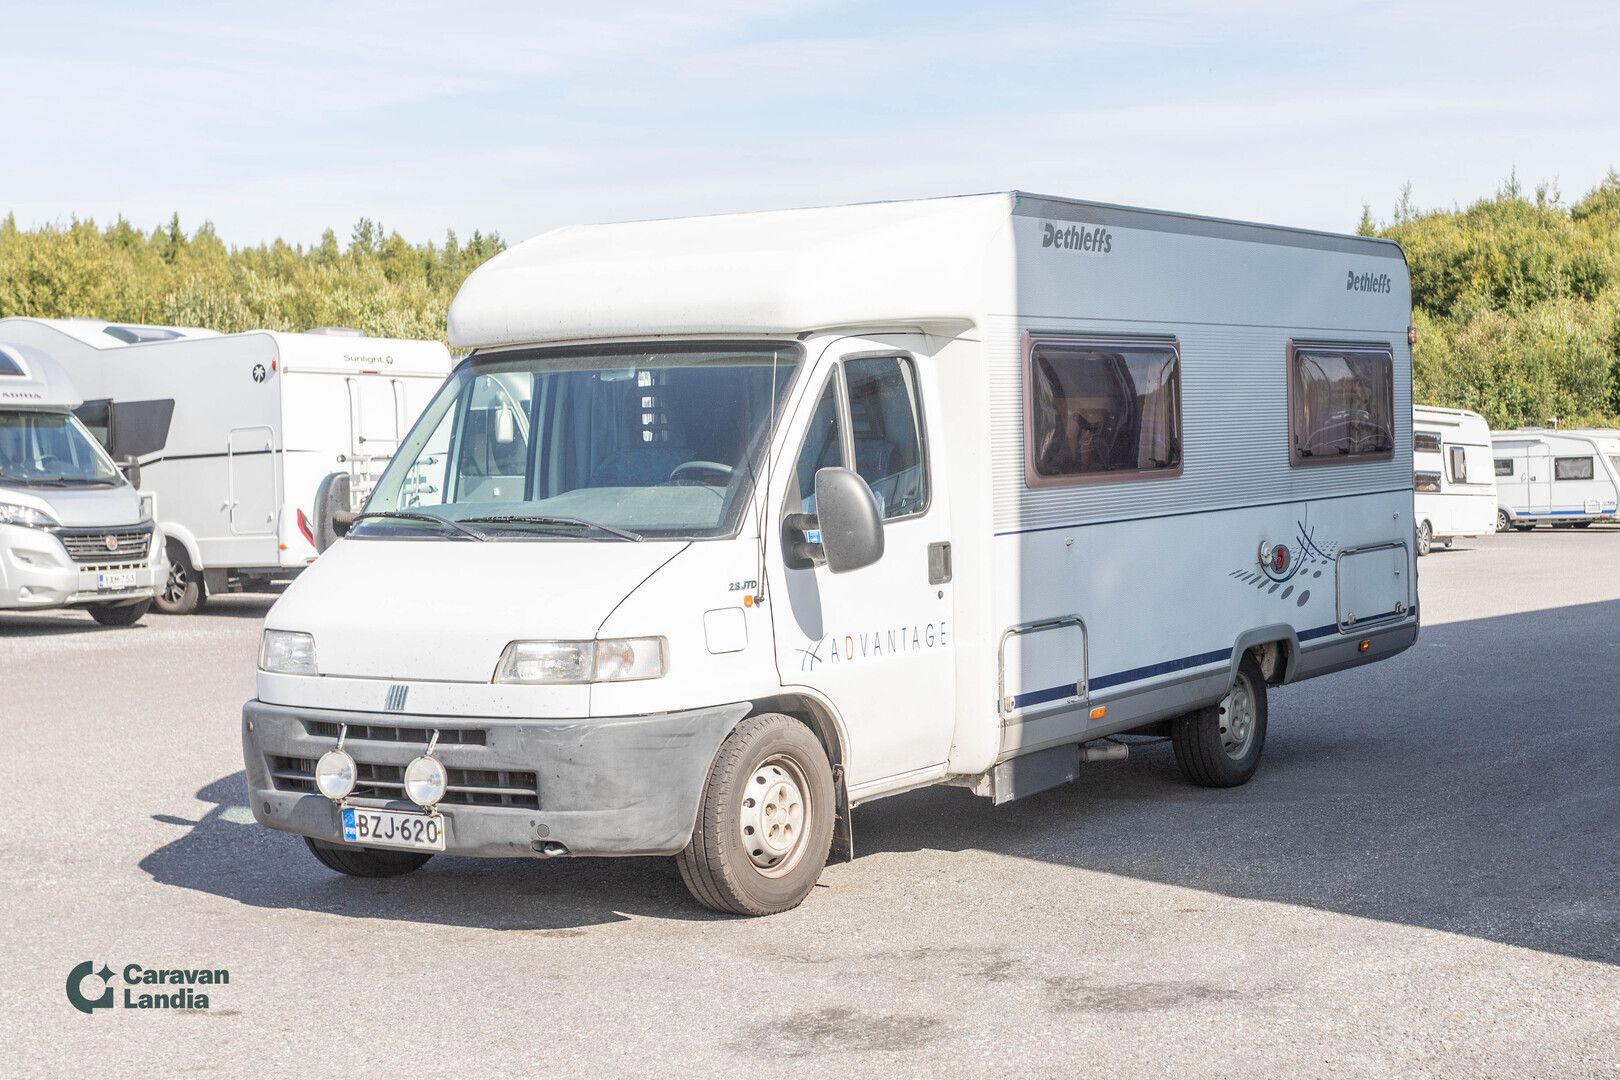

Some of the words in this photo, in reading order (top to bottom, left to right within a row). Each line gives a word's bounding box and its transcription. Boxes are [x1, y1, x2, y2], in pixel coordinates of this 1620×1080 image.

[1042, 222, 1113, 253] Dethleffs
[1346, 270, 1391, 294] Dethleffs
[343, 354, 383, 364] Sunlight
[831, 622, 946, 663] ADVANTAGE
[358, 814, 438, 843] BZJ-620
